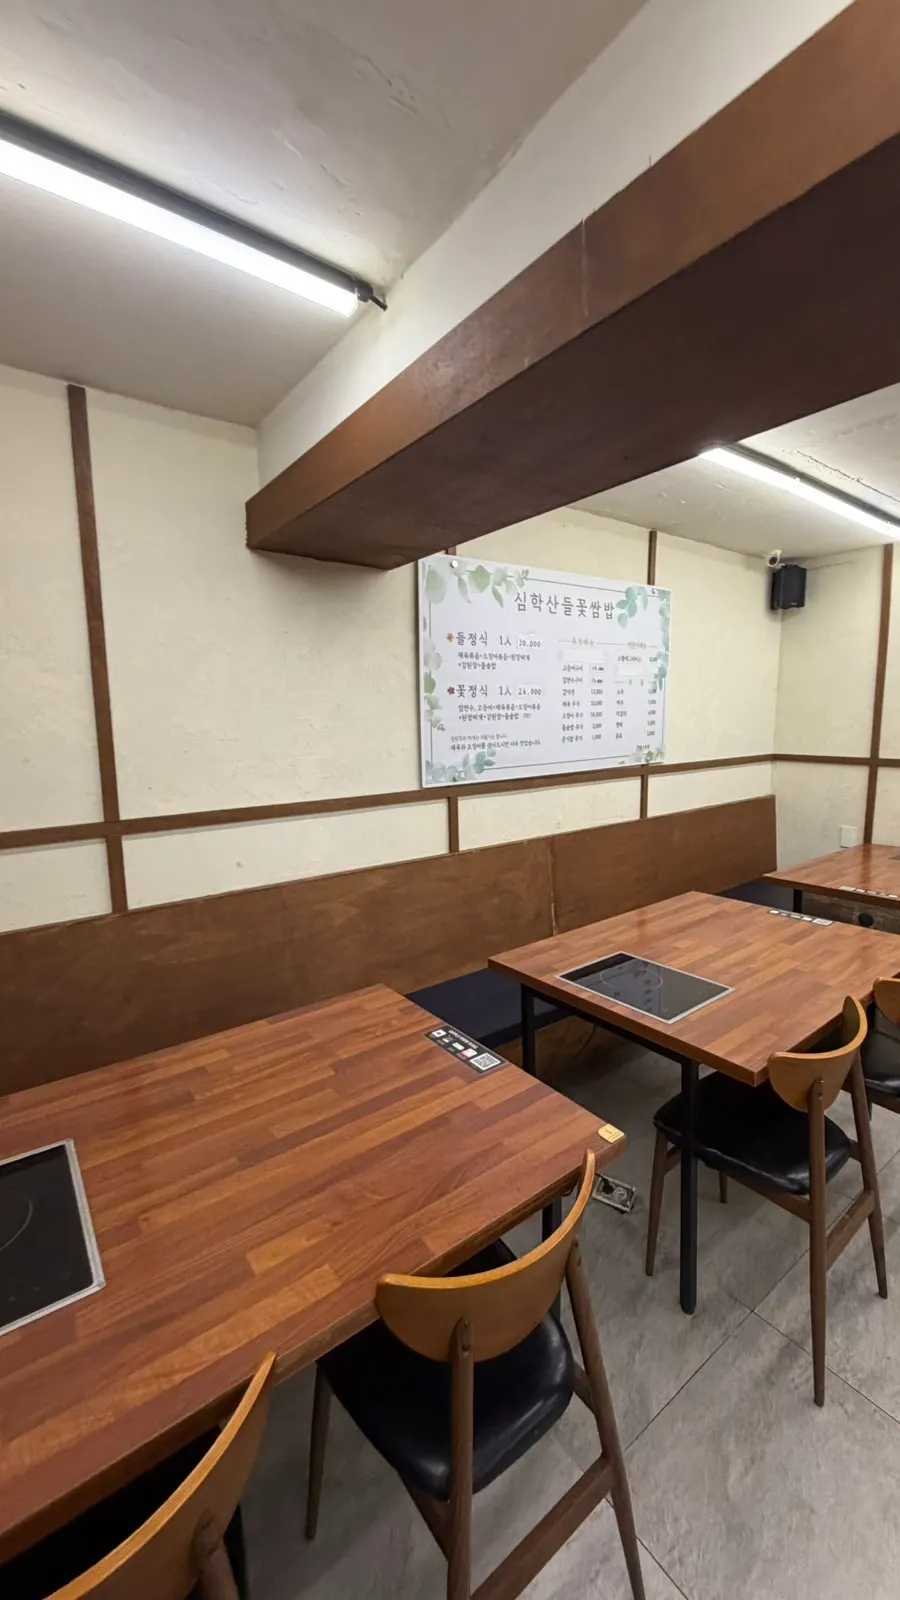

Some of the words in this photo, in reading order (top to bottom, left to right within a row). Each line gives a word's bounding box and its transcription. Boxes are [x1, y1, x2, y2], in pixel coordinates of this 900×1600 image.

[514, 592, 615, 620] 심학산들꽃쌈밥
[456, 631, 488, 646] 들정식
[456, 684, 488, 698] 꽃정식
